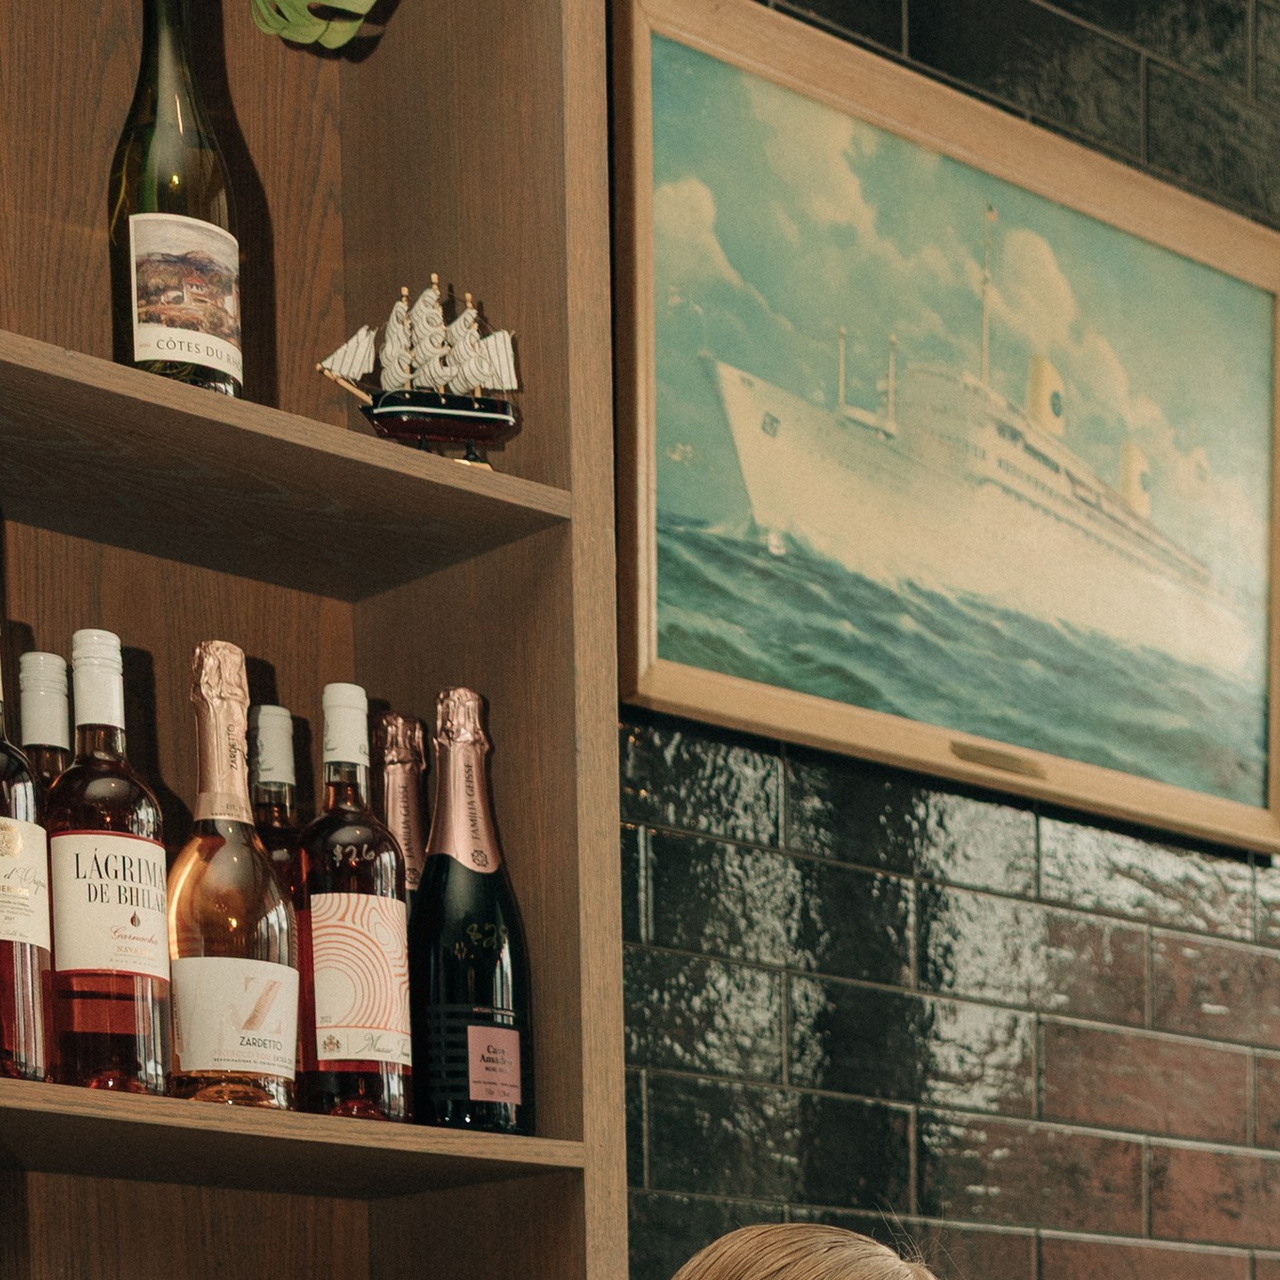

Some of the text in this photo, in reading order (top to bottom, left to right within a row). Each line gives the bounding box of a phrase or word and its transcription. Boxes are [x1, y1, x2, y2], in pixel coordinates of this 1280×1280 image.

[156, 338, 201, 354] CÔTES
[206, 346, 223, 360] DU
[226, 723, 238, 771] ZARDETTO
[464, 762, 475, 797] GEISSE
[333, 843, 376, 868] $26
[87, 883, 110, 904] DE
[240, 1036, 283, 1051] ZARDETTO
